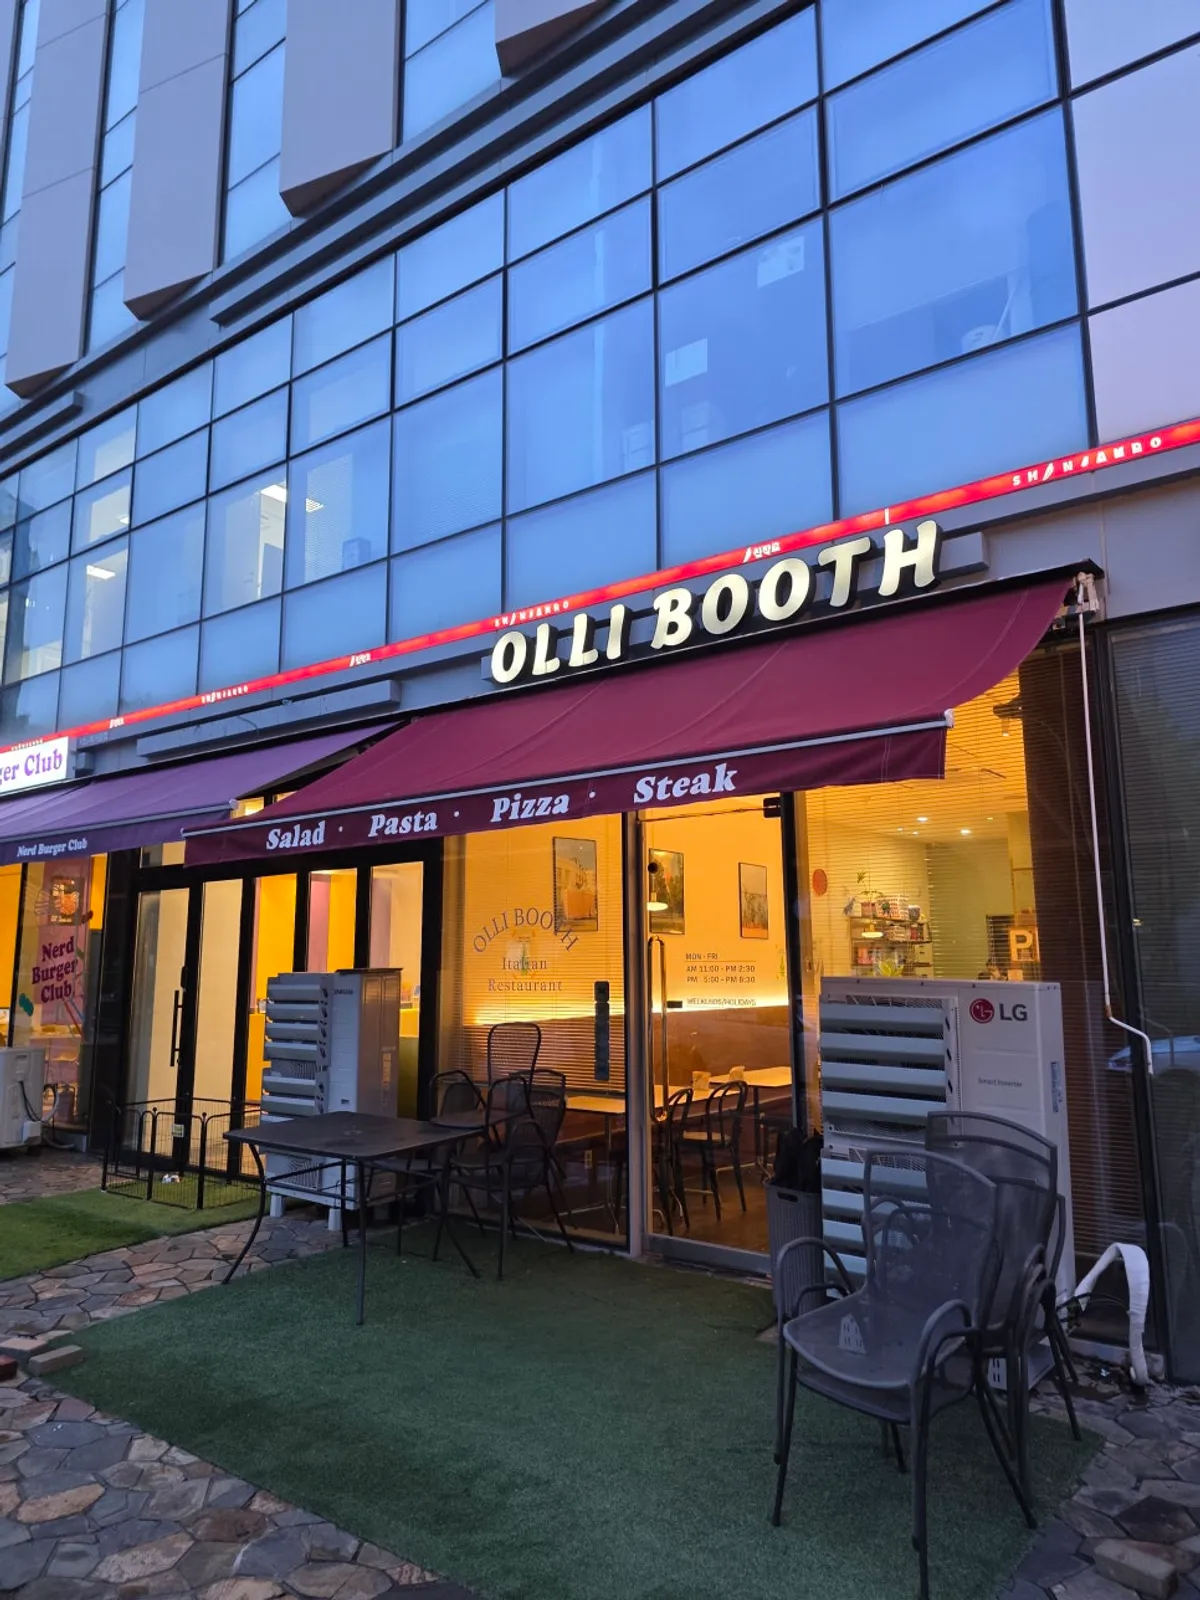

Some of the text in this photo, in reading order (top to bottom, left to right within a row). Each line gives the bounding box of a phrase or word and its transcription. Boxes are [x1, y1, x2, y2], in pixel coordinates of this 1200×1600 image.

[490, 520, 938, 683] OLLI BOOTH
[24, 748, 63, 777] Club
[266, 763, 738, 850] Salad Pasta Pizza Steak
[17, 838, 88, 857] Nerd Burger Club
[473, 911, 509, 953] OLLI
[42, 936, 75, 962] Nerd
[32, 959, 78, 985] Burger
[502, 957, 547, 970] Italian
[41, 981, 73, 1004] Club
[488, 979, 562, 991] Restaurant
[999, 1003, 1028, 1021] LG
